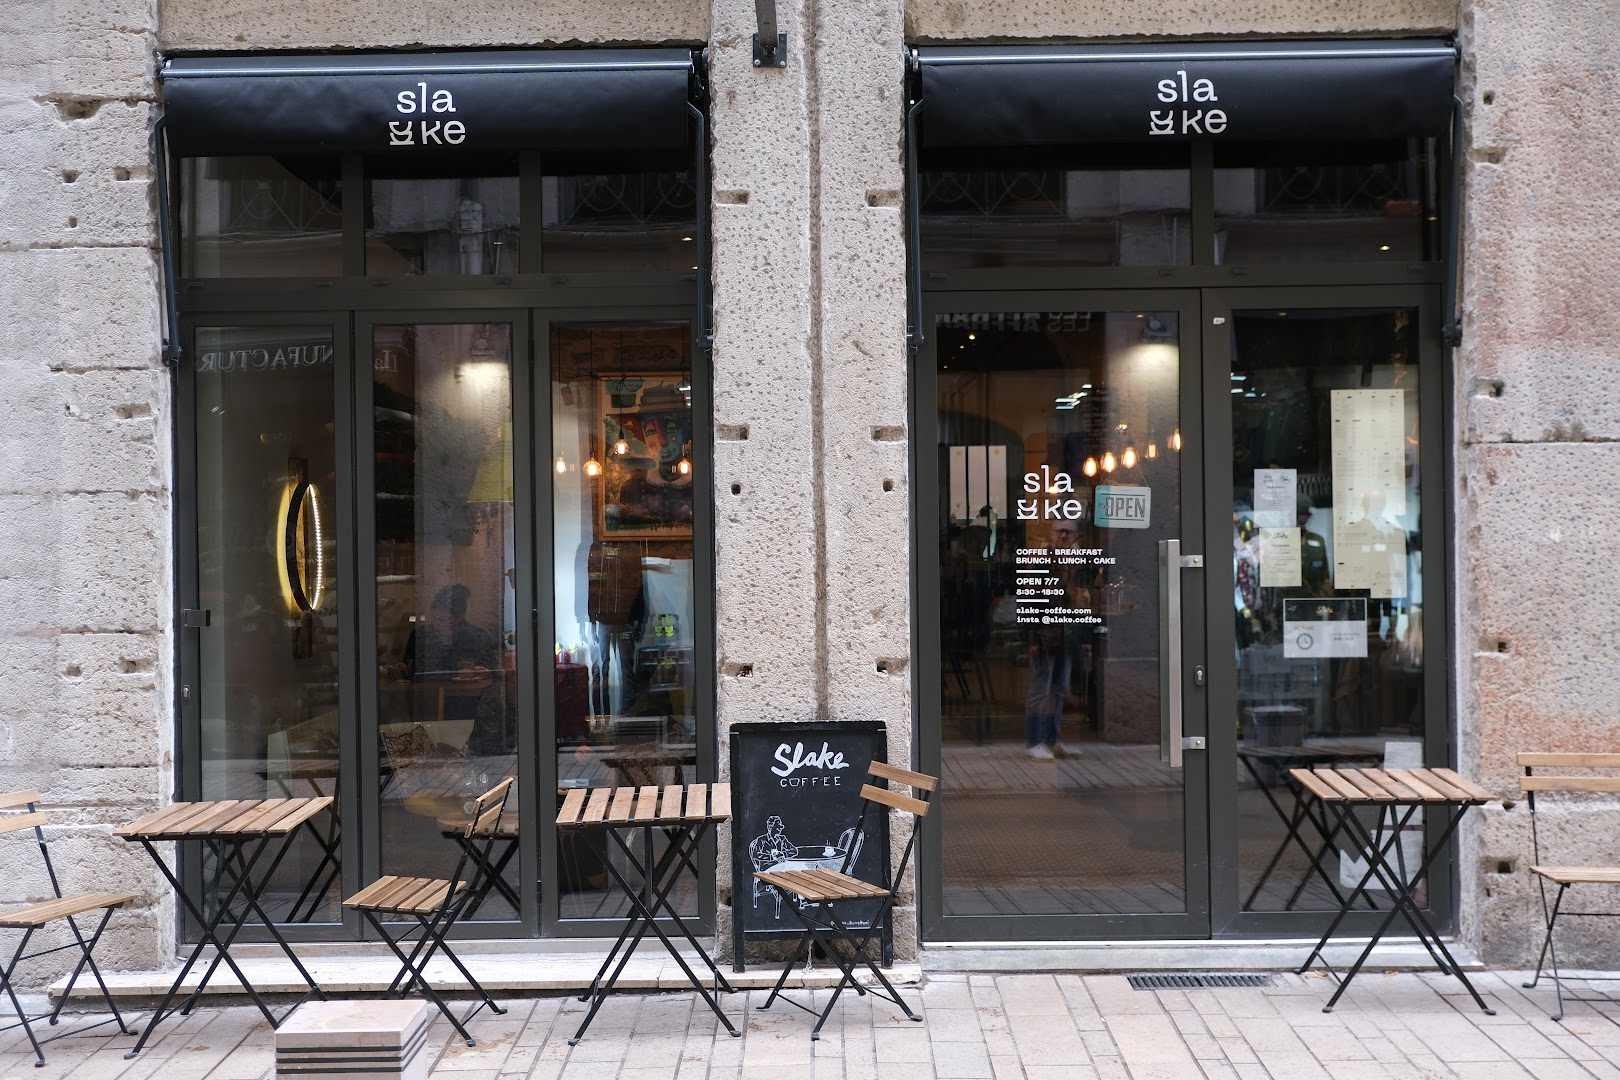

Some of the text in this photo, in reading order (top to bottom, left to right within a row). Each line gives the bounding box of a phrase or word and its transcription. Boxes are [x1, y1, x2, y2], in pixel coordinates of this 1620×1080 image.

[1157, 70, 1218, 103] sla
[396, 81, 457, 114] sla
[1023, 464, 1075, 494] sla
[1105, 495, 1146, 518] OPEN
[1015, 548, 1103, 556] COFFEE BREAKFAST
[1015, 557, 1117, 565] BRUNCH LUNCH CAKE
[1015, 577, 1060, 586] OPEN 7/7
[1016, 615, 1040, 624] insta
[770, 741, 850, 778] Slake
[779, 776, 842, 788] COFFEE
